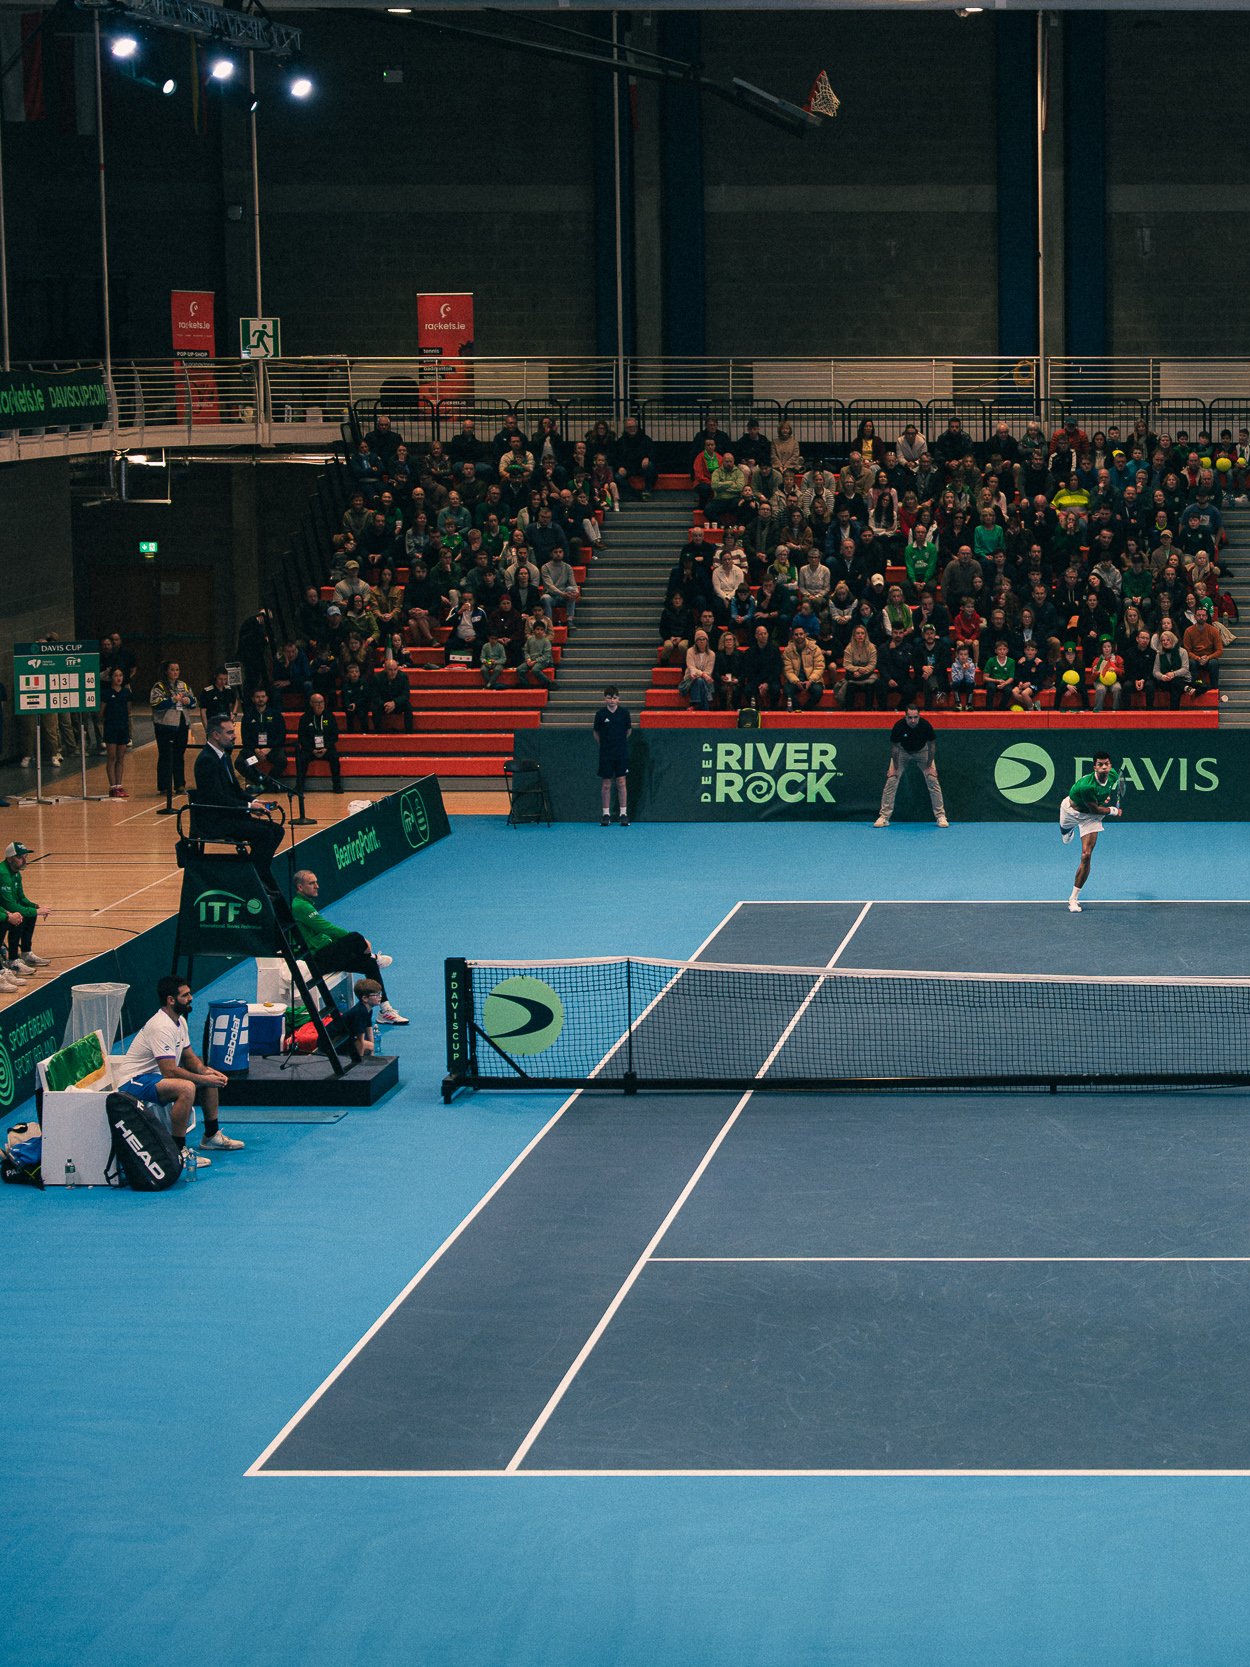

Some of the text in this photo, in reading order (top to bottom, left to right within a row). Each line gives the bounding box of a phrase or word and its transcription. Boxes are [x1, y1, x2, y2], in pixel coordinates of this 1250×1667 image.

[0, 382, 45, 416] ackets.ie
[41, 644, 65, 652] DAVIS
[52, 678, 57, 686] 1
[62, 677, 68, 686] 3
[52, 695, 95, 705] 6 5 40
[716, 742, 838, 771] RIVER
[700, 743, 713, 803] DEEP
[199, 901, 242, 923] ITF
[451, 971, 460, 1060] #DAVISCUP
[224, 1014, 241, 1066] Babolat
[115, 1120, 166, 1180] HEAD
